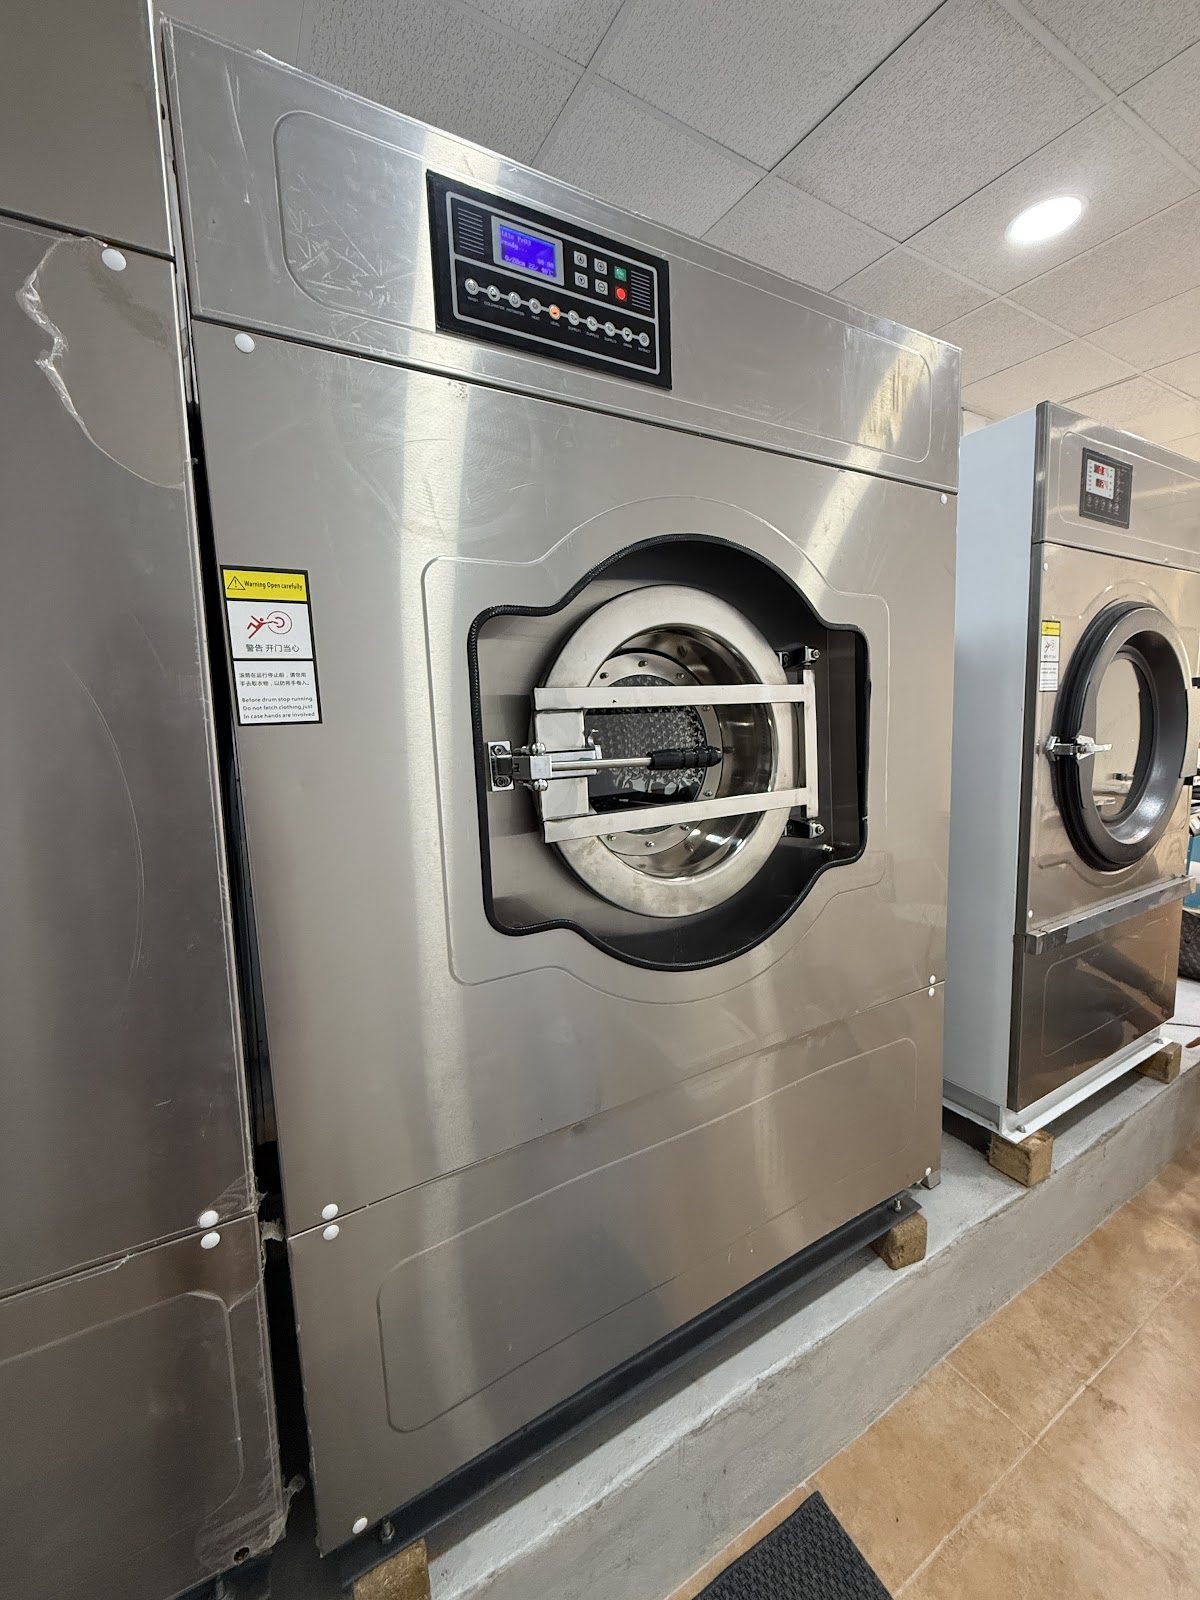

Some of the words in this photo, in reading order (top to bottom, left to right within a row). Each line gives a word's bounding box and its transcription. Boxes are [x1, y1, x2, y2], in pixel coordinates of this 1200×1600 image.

[244, 580, 266, 589] Warning
[267, 581, 280, 589] Open
[281, 582, 303, 591] carefully
[246, 643, 263, 652] 警告
[265, 643, 299, 652] 开门当心
